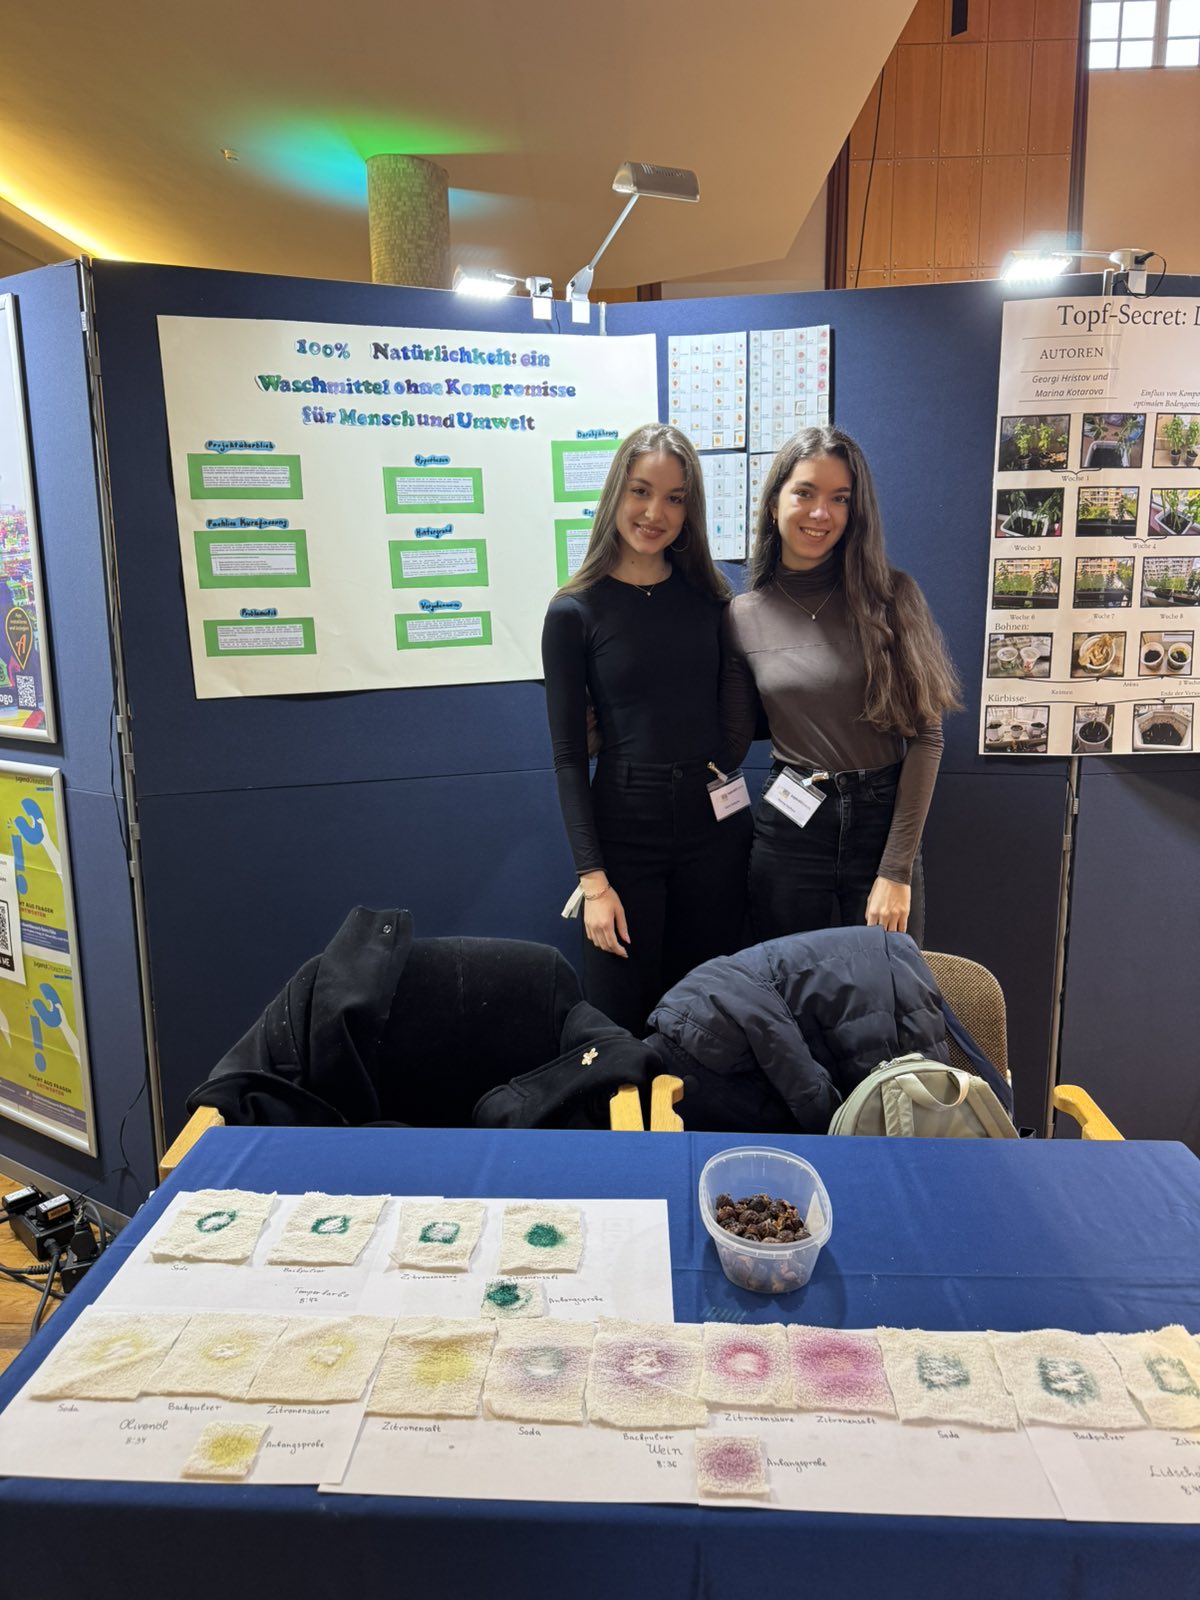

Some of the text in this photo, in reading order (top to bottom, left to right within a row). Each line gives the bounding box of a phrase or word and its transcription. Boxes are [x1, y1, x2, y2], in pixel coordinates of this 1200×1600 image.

[1057, 303, 1187, 332] Topf-Secret:
[296, 338, 551, 367] 100% Natürlichkeit: ein
[1040, 347, 1104, 360] AUTOREN
[1032, 372, 1109, 385] Georgi Hristov und
[256, 373, 577, 400] Waschmittel ohne Kompromisse
[1035, 388, 1065, 398] Marina
[301, 405, 536, 431] für Mensch und Umwelt
[995, 622, 1030, 631] Bohnen:
[988, 693, 1027, 702] Kürbisse:
[58, 1403, 80, 1413] Soda
[381, 1421, 442, 1433] Zitronensaft
[518, 1426, 542, 1437] Soda
[937, 1429, 961, 1440] Soda
[646, 1442, 684, 1457] Wein
